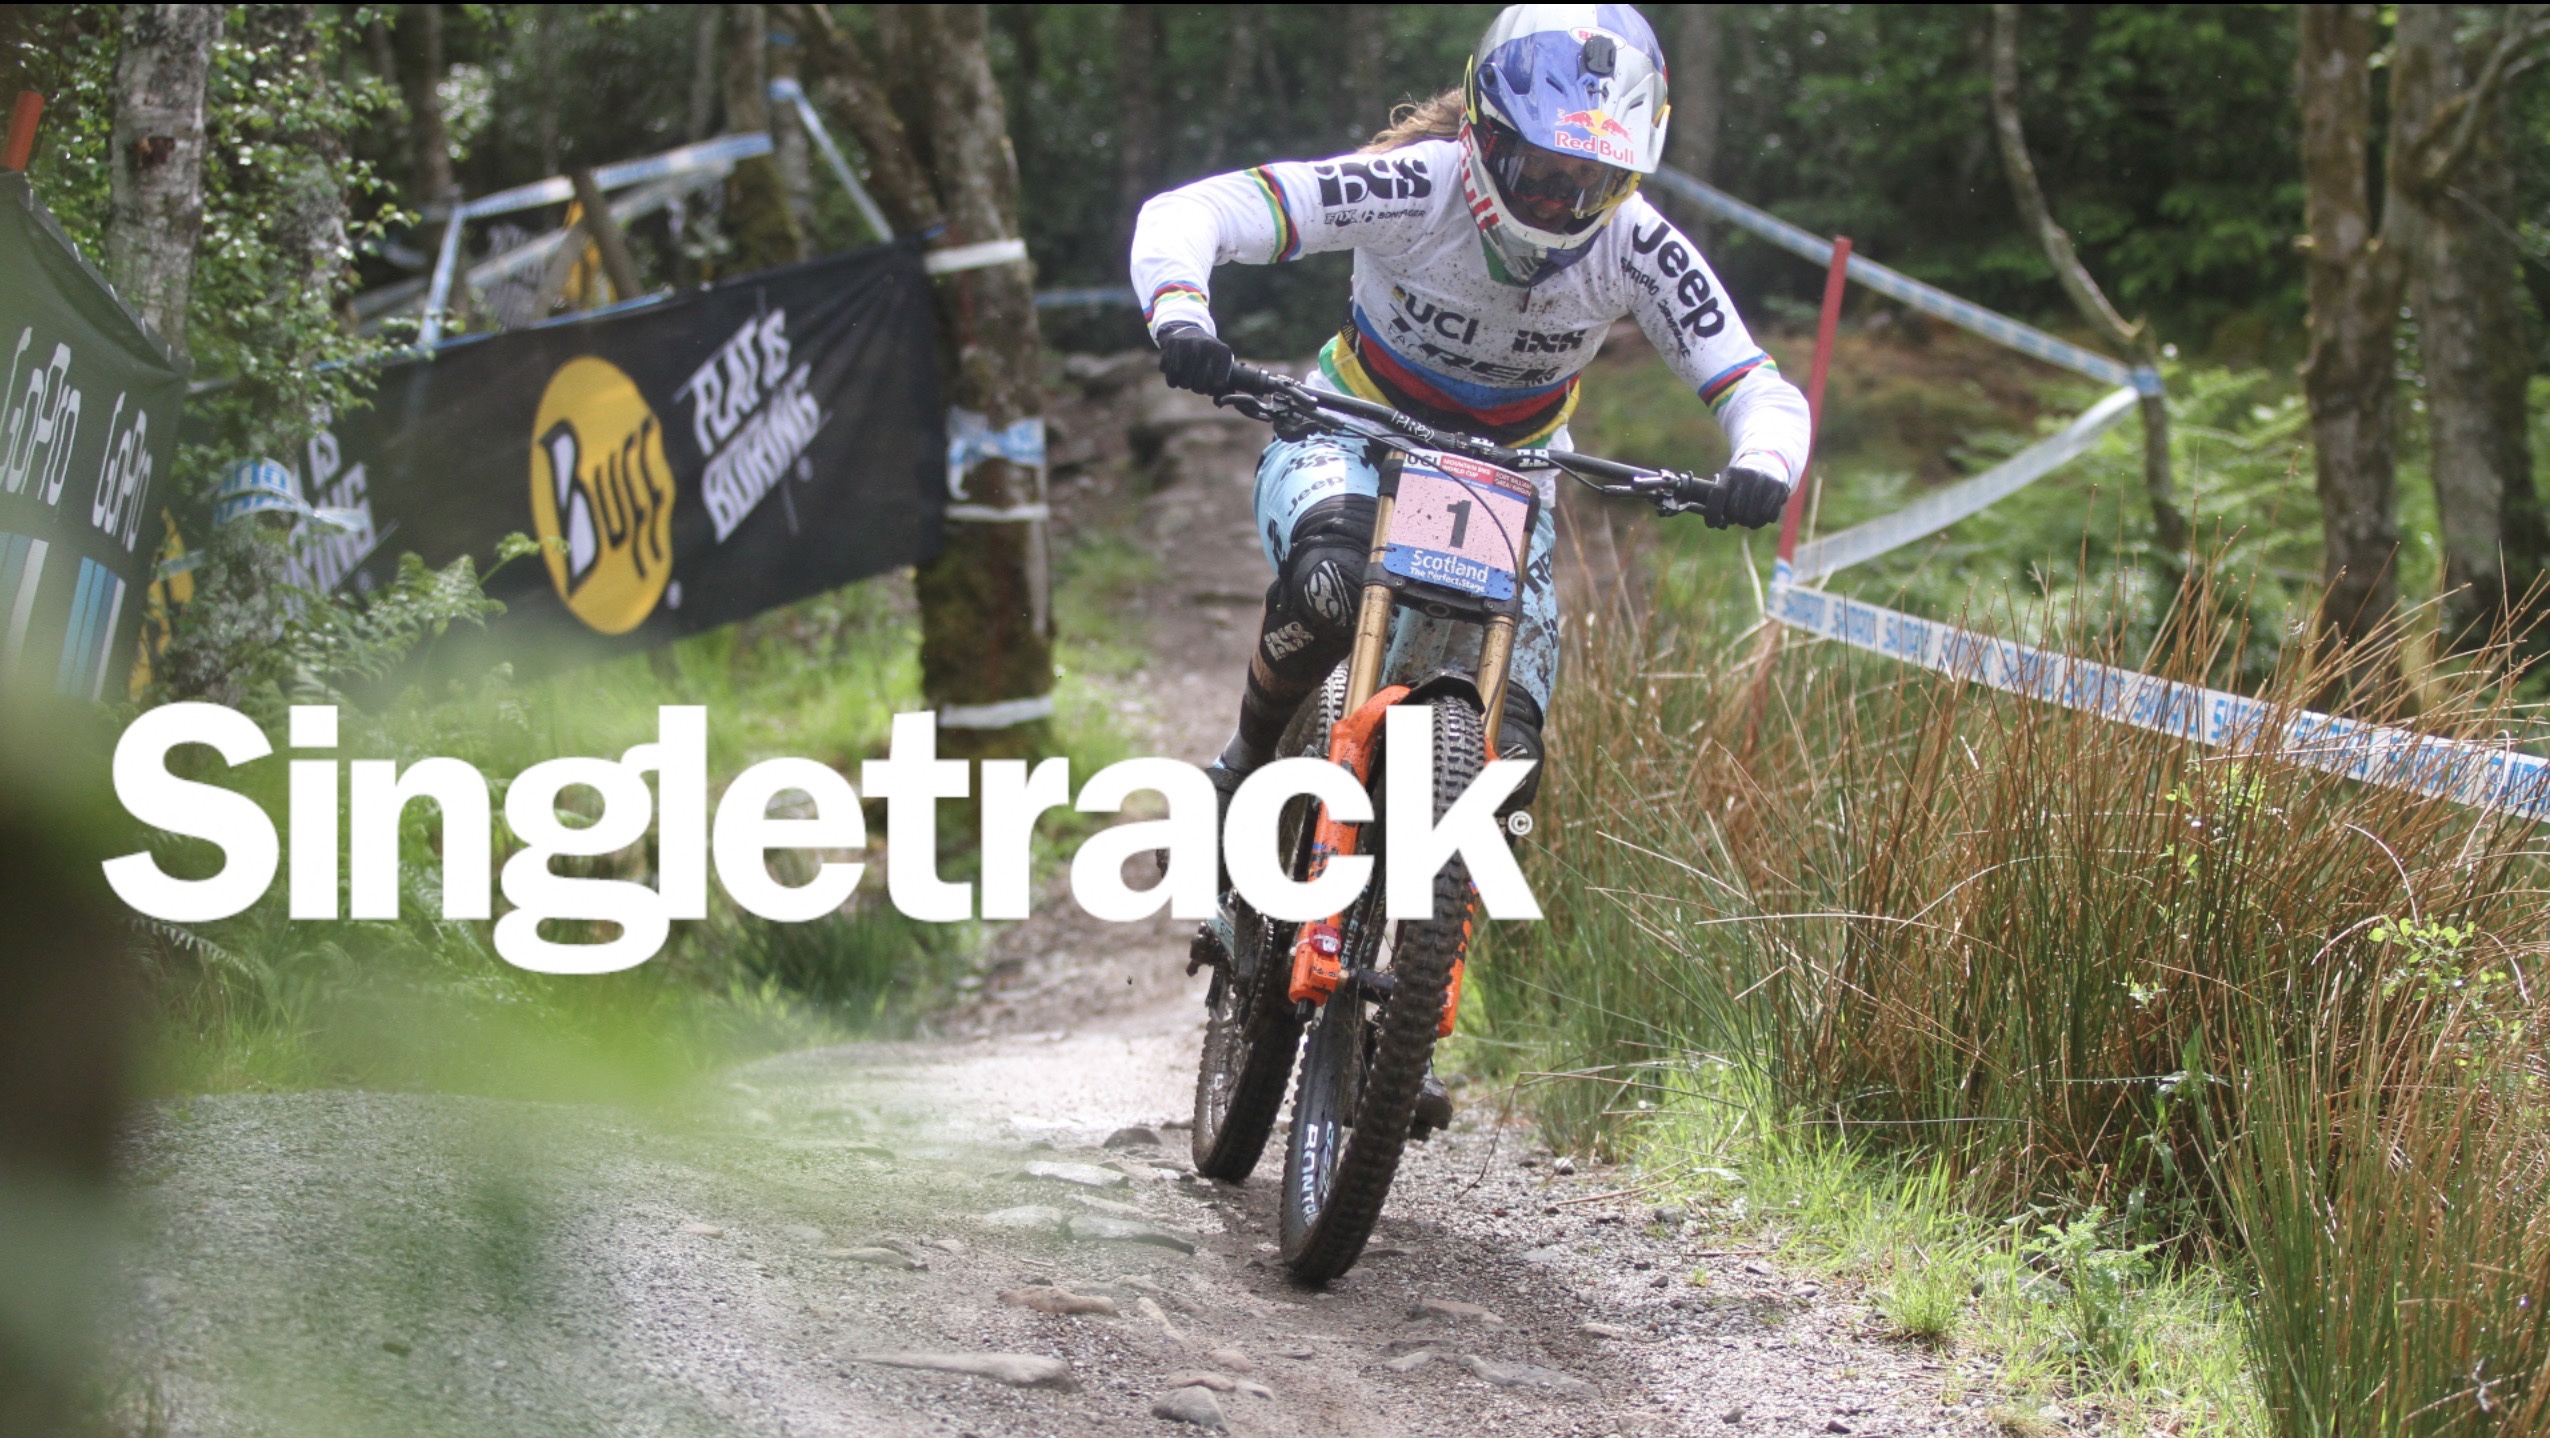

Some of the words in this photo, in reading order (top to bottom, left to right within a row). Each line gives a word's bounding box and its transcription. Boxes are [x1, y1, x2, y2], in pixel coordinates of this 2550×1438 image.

[1555, 131, 1597, 154] Red
[1598, 137, 1635, 164] Bull
[1324, 208, 1358, 227] FOX
[1377, 208, 1426, 219] BONTAGER
[1632, 222, 1725, 338] Jeep
[1405, 292, 1480, 345] UCI
[0, 326, 81, 506] GoPro
[92, 391, 152, 553] GoPro
[1406, 452, 1440, 467] UCI
[1465, 468, 1479, 479] CUP
[1287, 476, 1344, 517] Jeep
[1446, 499, 1472, 549] 1
[1410, 566, 1427, 579] The
[1411, 550, 1489, 584] Scotland
